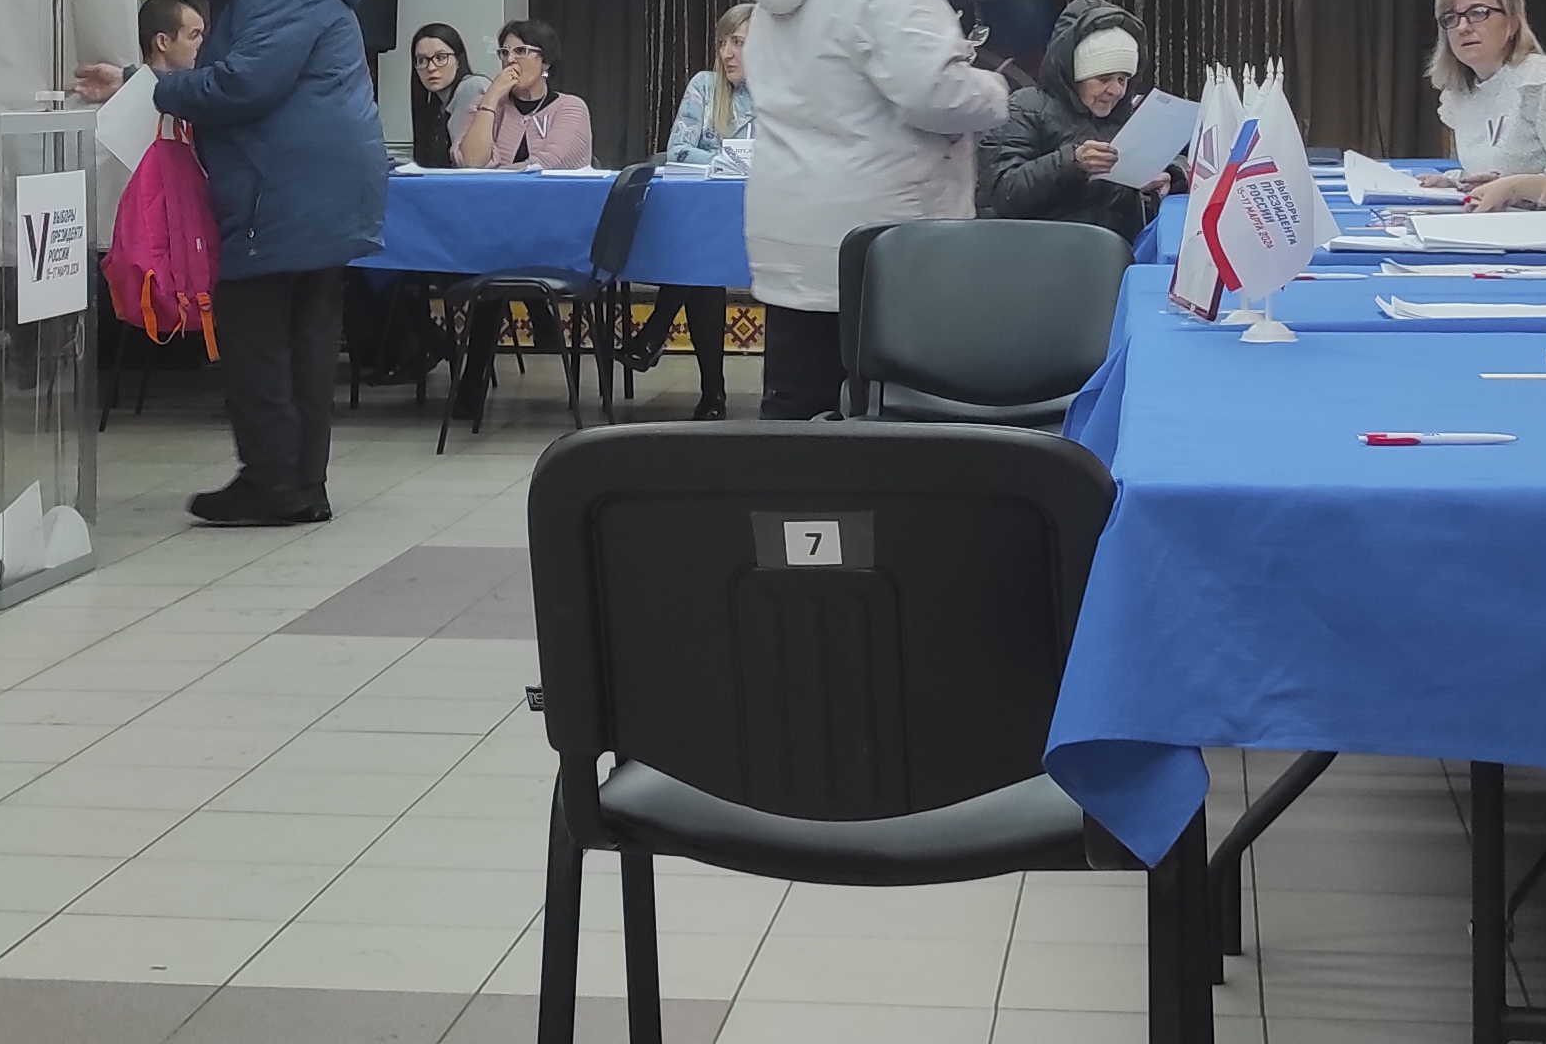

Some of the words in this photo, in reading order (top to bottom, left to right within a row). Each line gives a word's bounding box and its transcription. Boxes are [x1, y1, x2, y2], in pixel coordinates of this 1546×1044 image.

[1246, 183, 1275, 223] РОССИИ
[1260, 181, 1298, 246] ПРЕЗИДЕНТА
[1273, 179, 1301, 224] ВЫБОРЫ
[804, 532, 823, 556] 7
